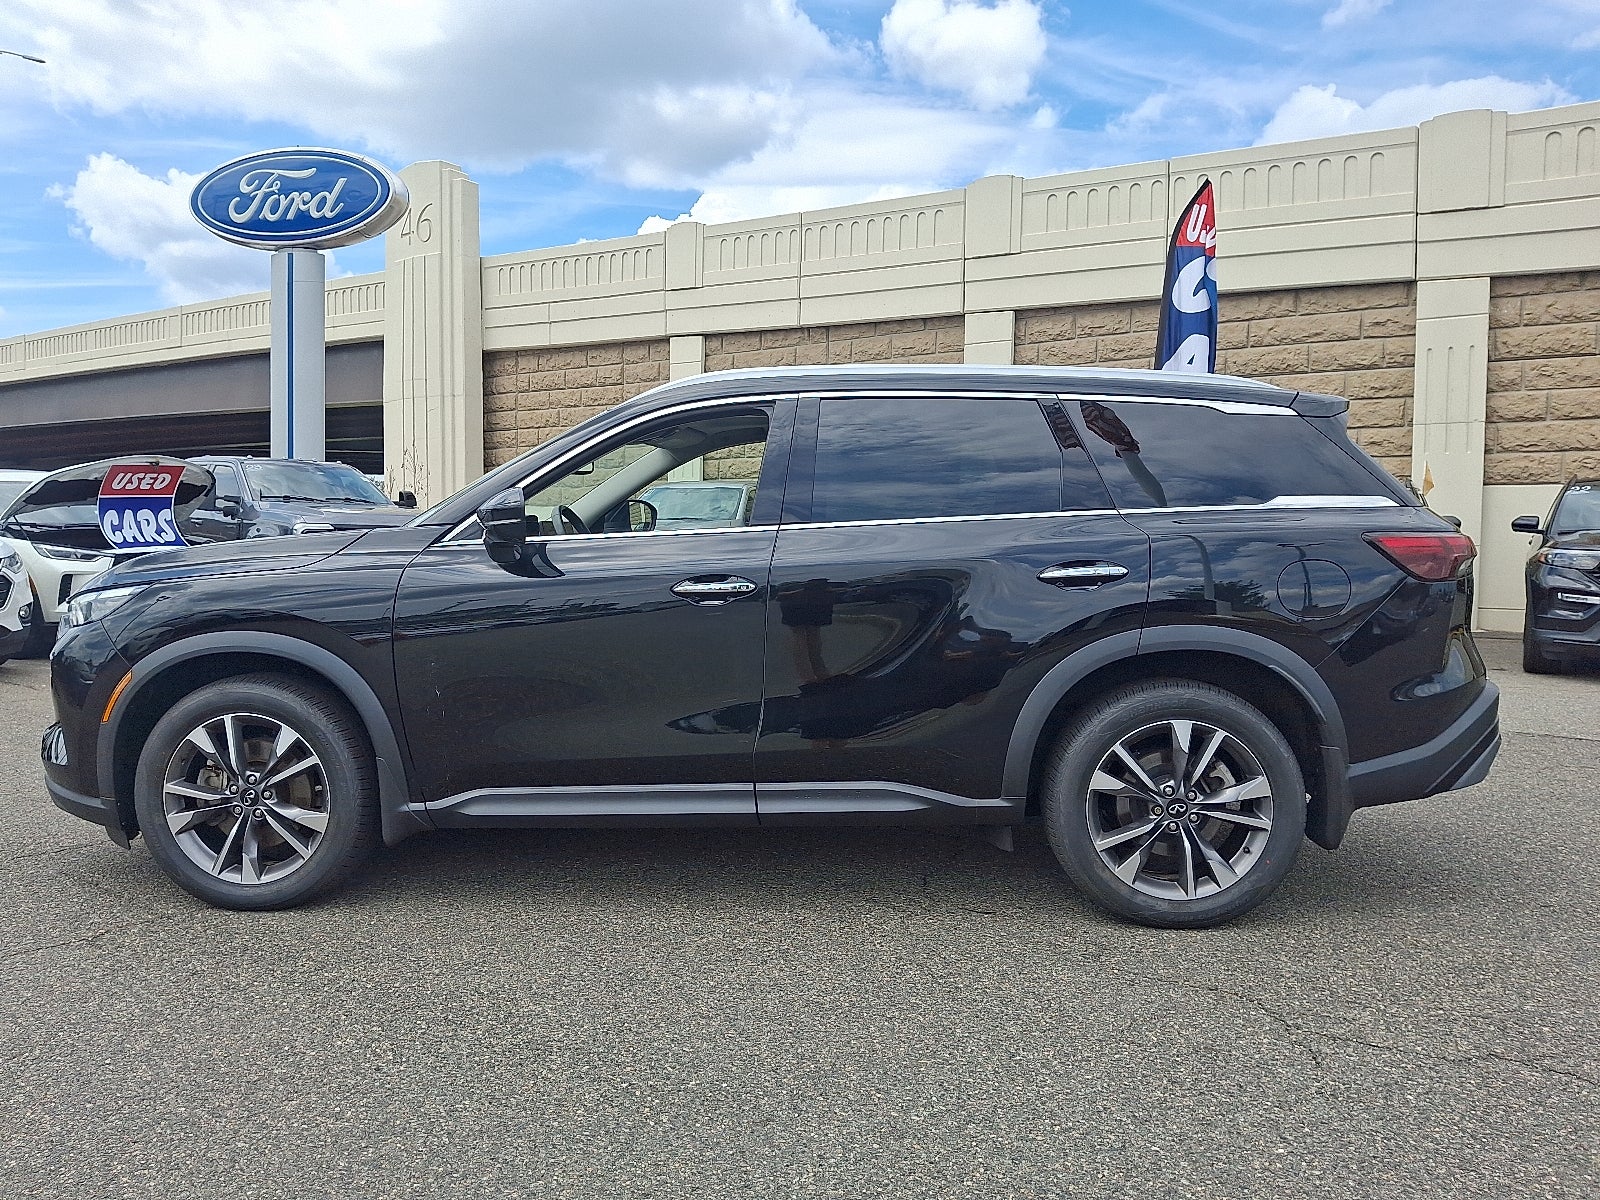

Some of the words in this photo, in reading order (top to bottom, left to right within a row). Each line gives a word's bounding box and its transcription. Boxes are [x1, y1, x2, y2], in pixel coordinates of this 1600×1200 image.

[228, 168, 348, 224] Ford
[400, 203, 433, 246] 46
[111, 472, 172, 490] USED
[103, 508, 177, 544] CARS
